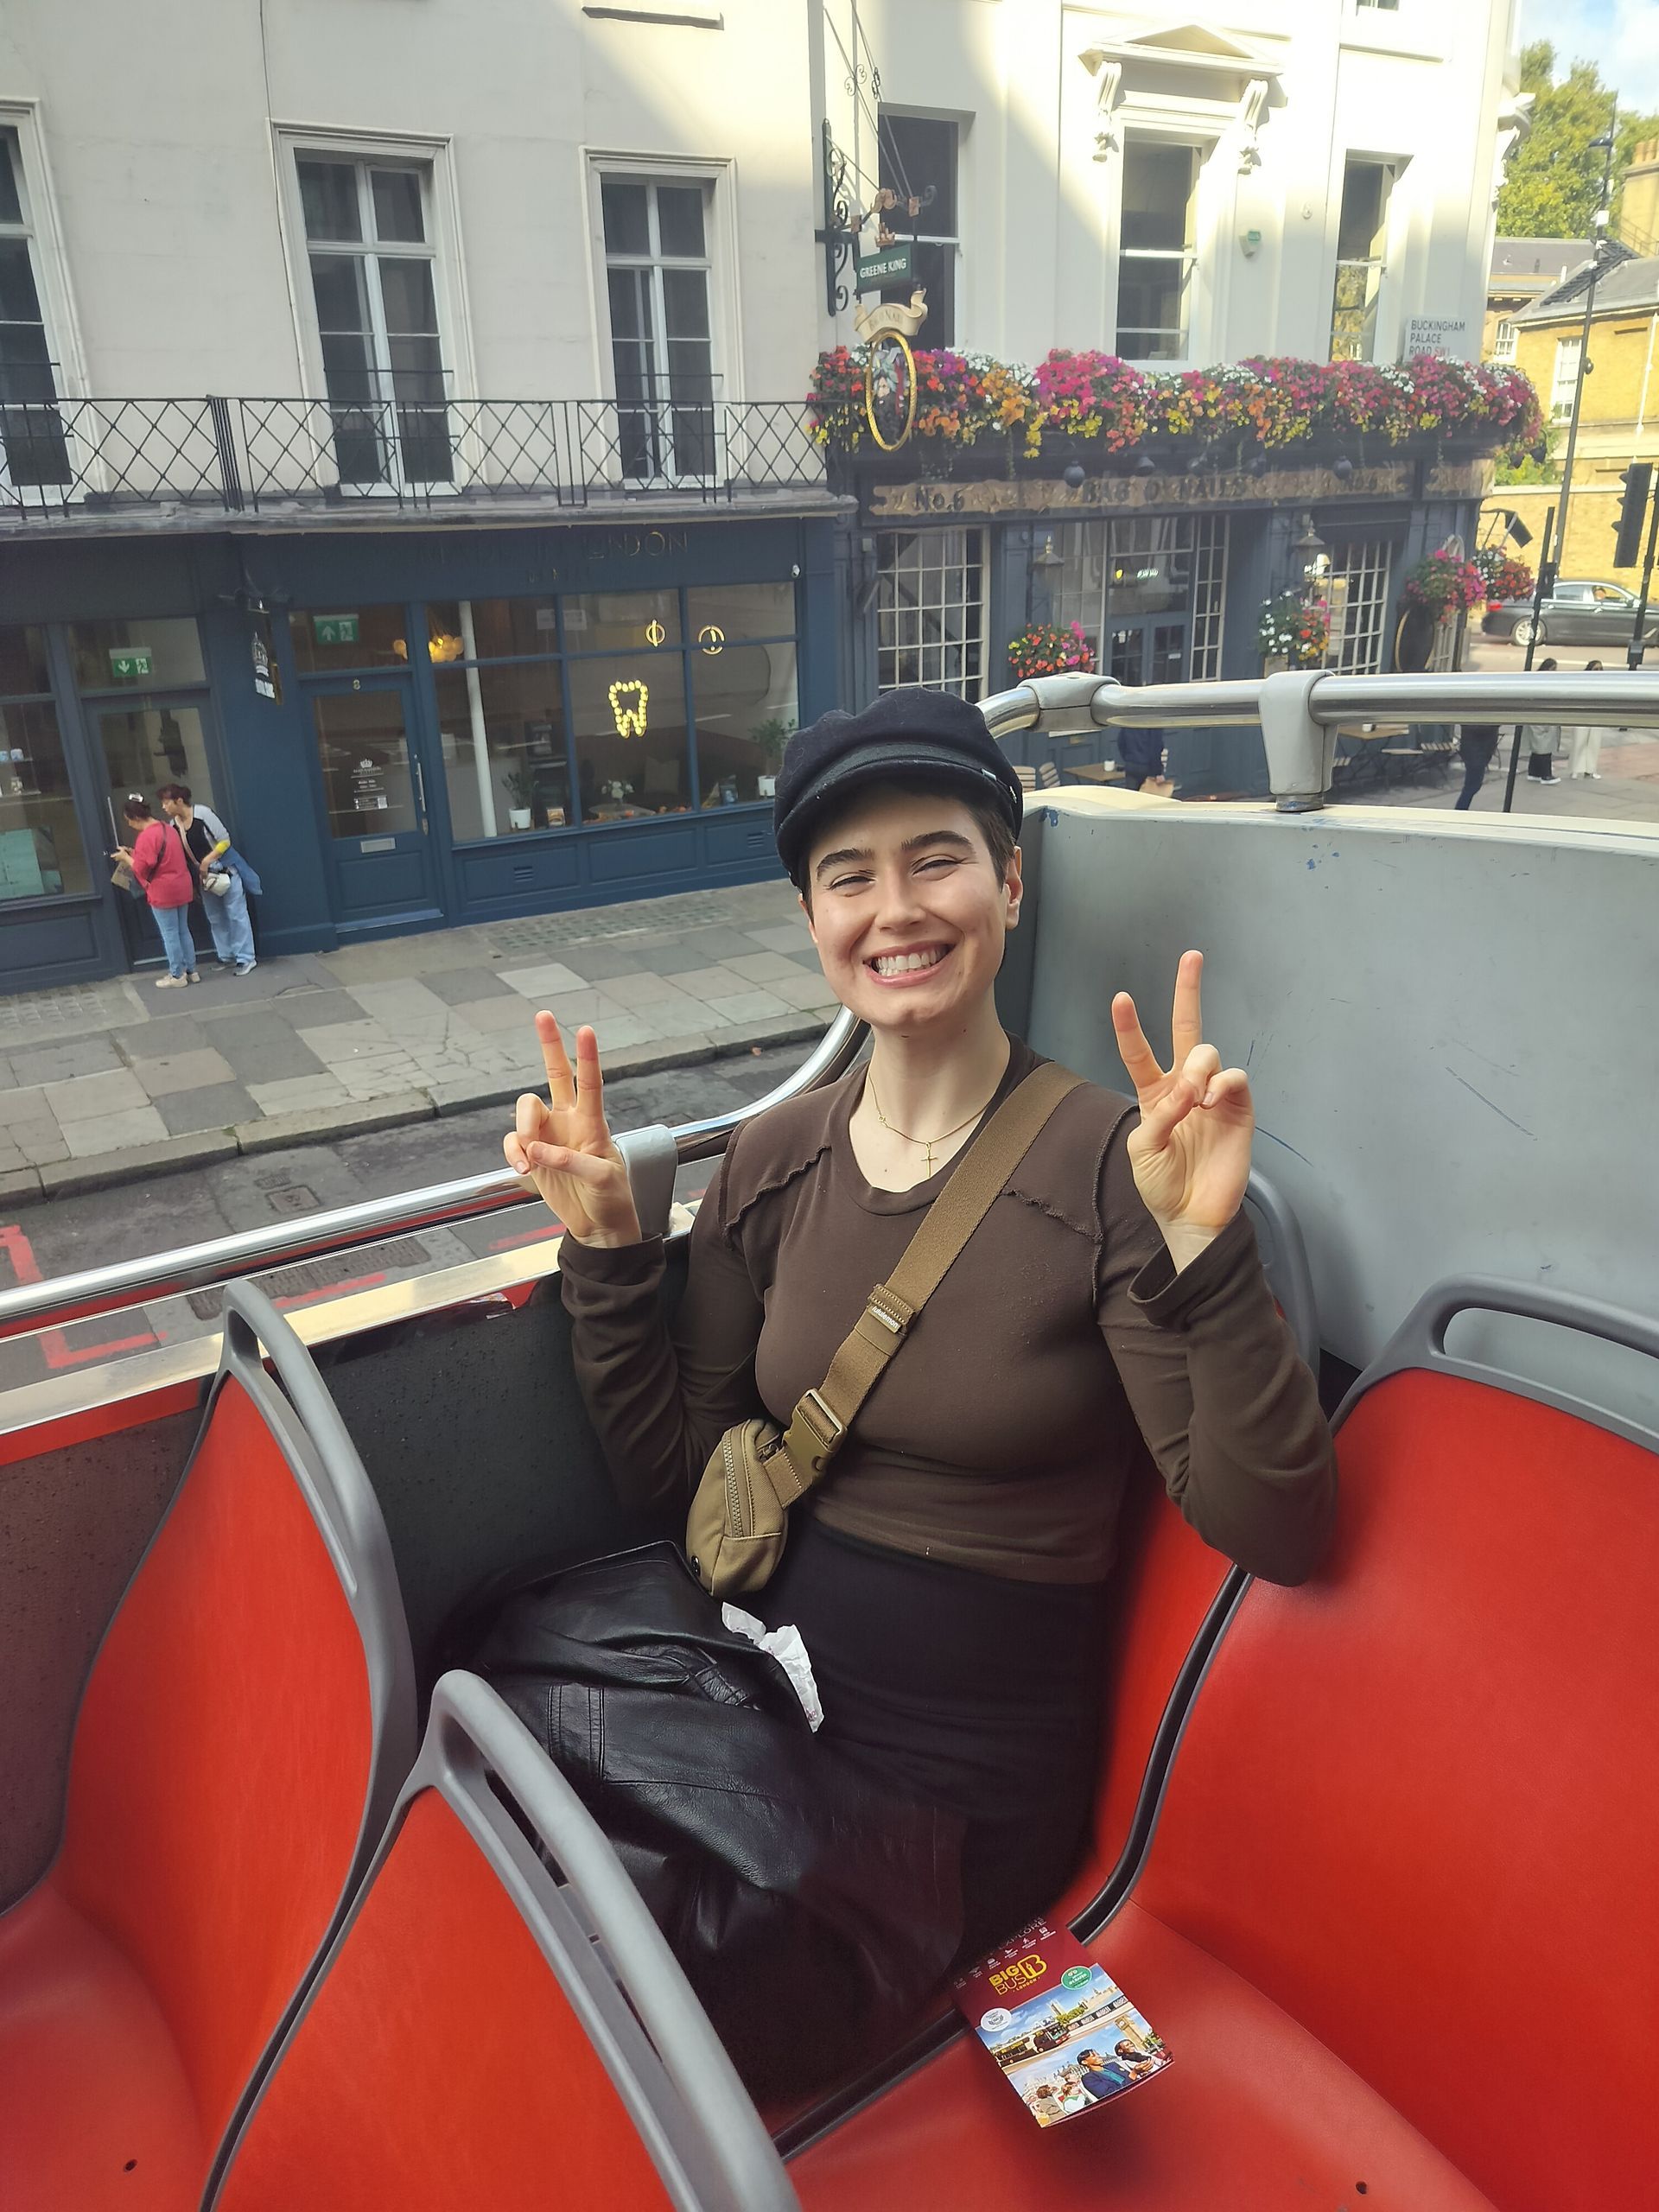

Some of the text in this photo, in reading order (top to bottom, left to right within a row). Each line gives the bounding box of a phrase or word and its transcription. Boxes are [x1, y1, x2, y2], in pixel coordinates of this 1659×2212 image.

[860, 262, 887, 278] GREENE
[887, 258, 907, 272] KING
[1411, 319, 1465, 331] BUCKINGHAM
[1409, 333, 1442, 343] PALACE
[1408, 345, 1432, 356] ROAD
[913, 484, 968, 512] No.6
[353, 679, 361, 690] 8
[871, 1306, 899, 1329] lululemon
[988, 1965, 1020, 1986] BIG
[995, 1973, 1027, 1995] BUS
